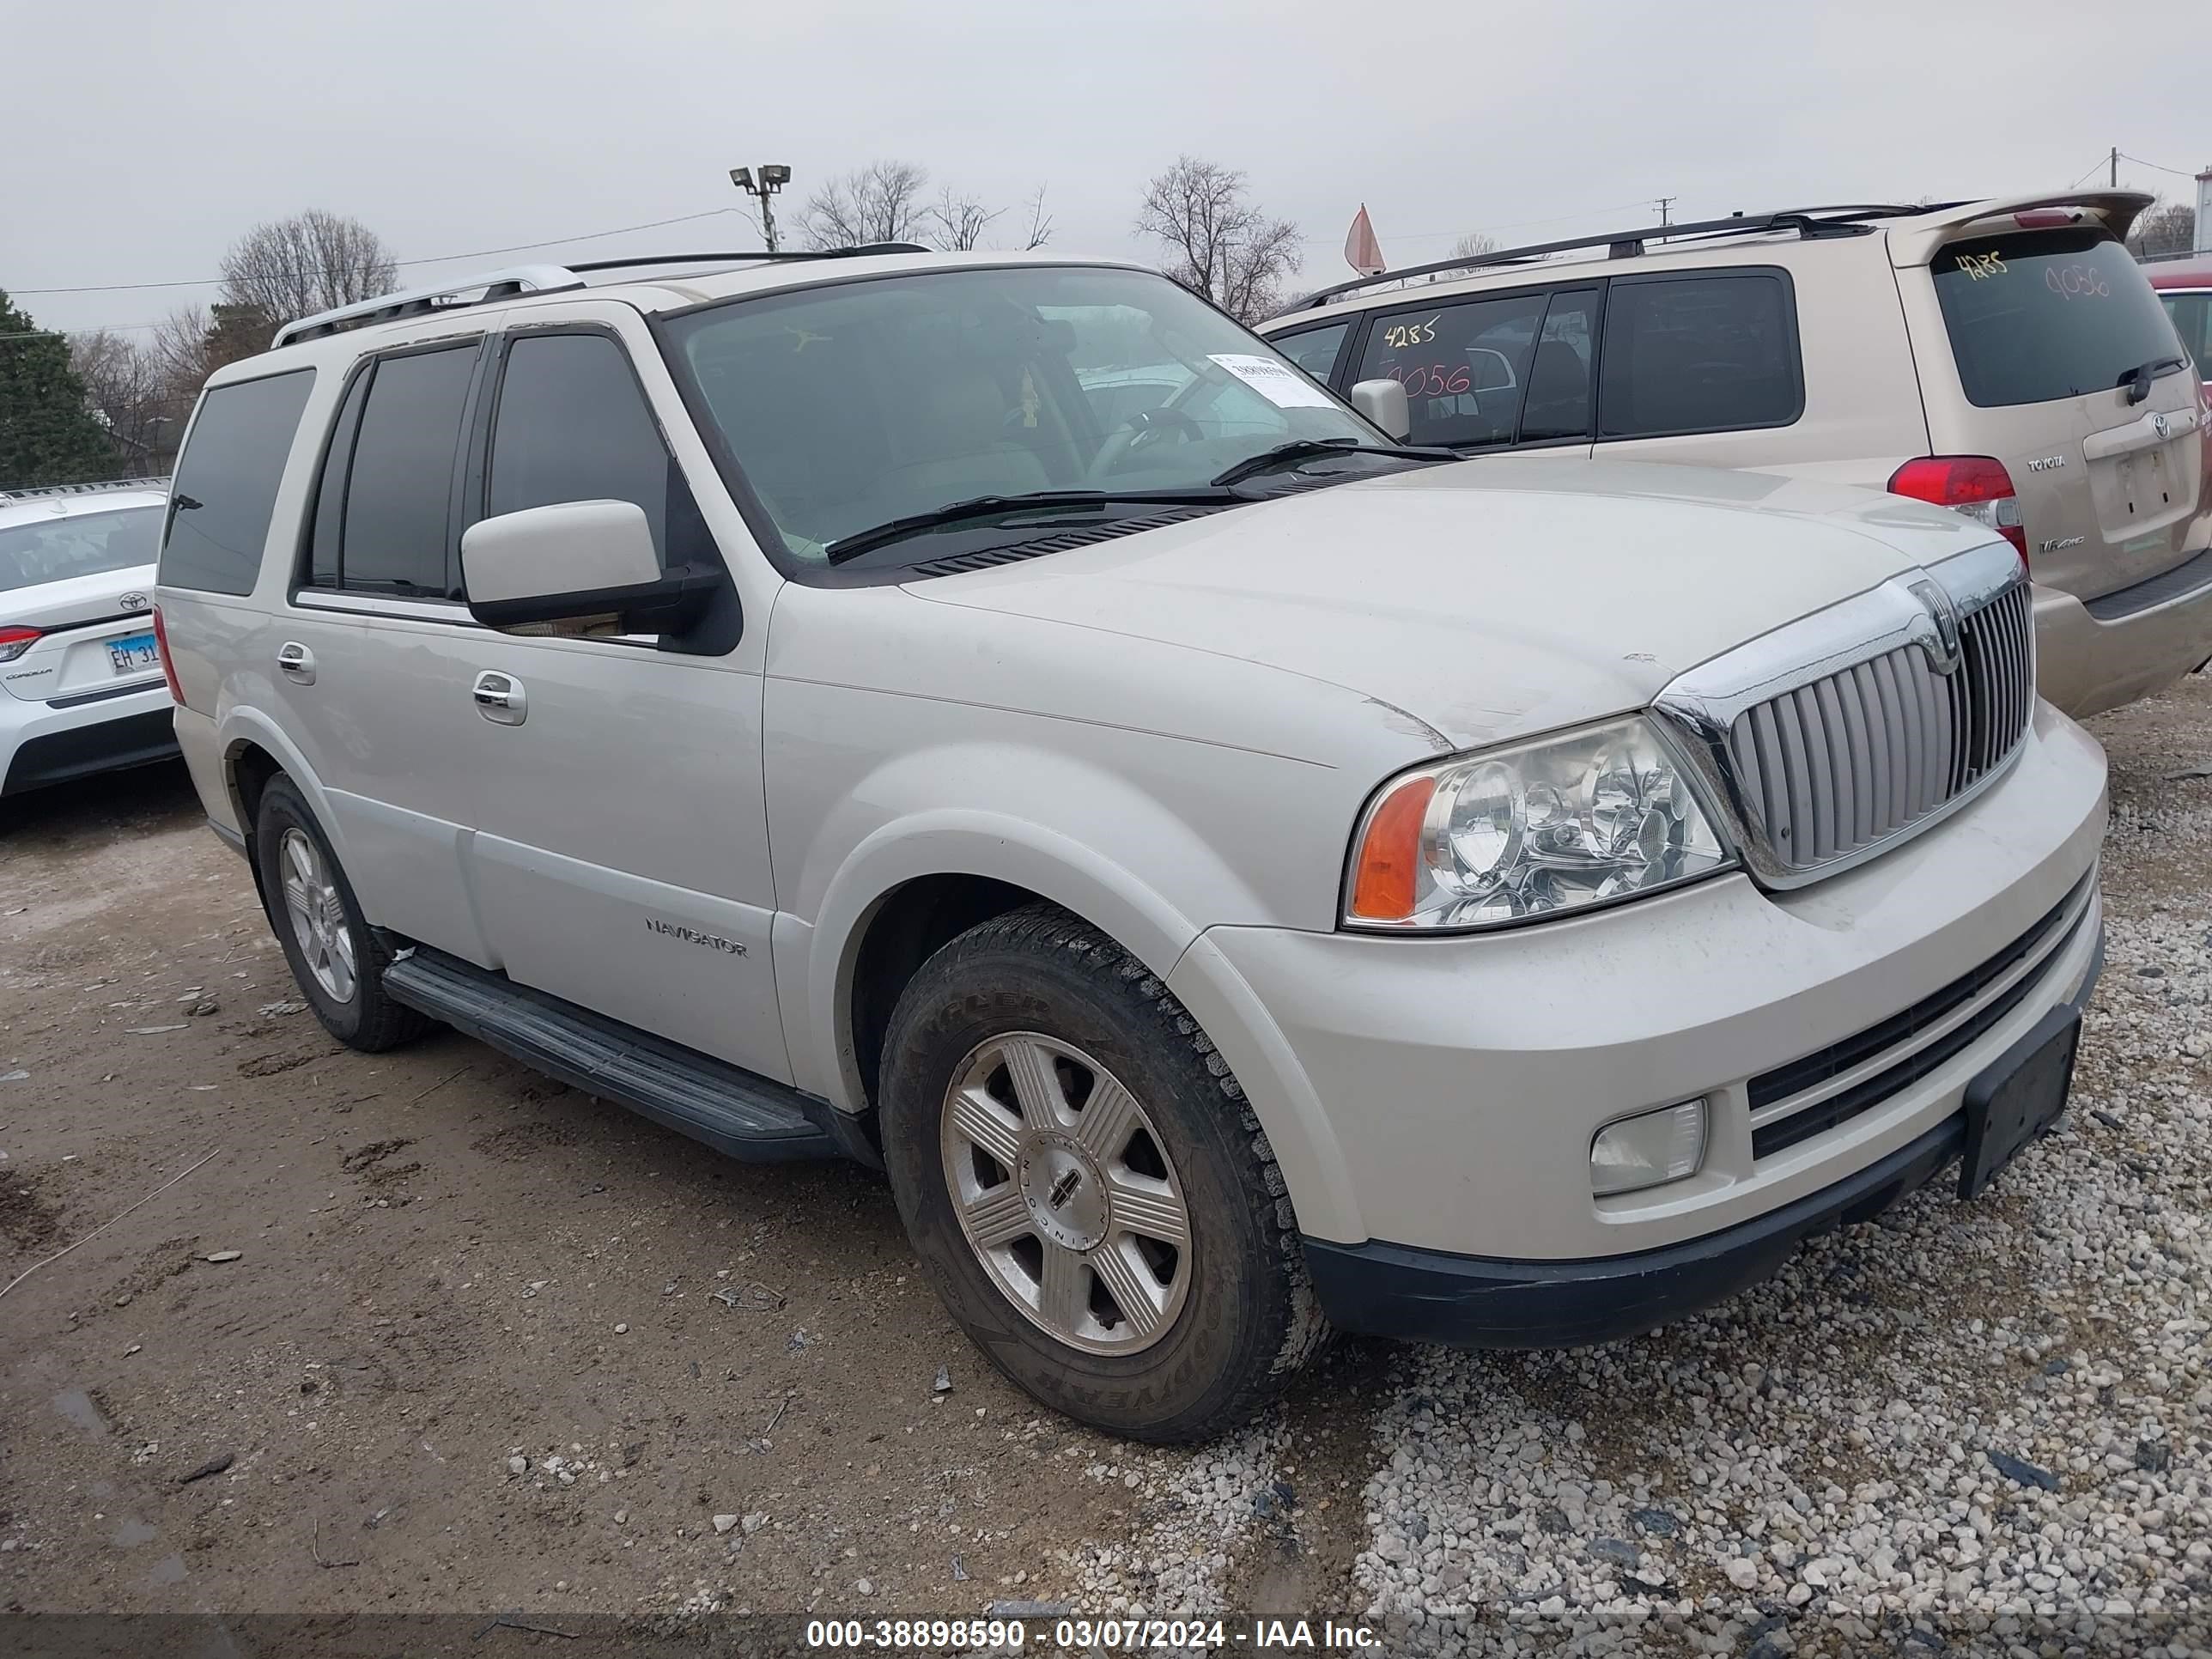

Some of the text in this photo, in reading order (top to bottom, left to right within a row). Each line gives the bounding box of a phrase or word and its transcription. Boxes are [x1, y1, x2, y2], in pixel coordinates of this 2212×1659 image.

[1954, 251, 2008, 282] 4285
[2045, 264, 2111, 301] 9056
[1383, 314, 1442, 348] 4285
[2027, 455, 2066, 472] TOYOTA
[110, 648, 133, 669] EH
[645, 915, 750, 958] NAVIGATOR
[1023, 1159, 1090, 1245] LINCOLN
